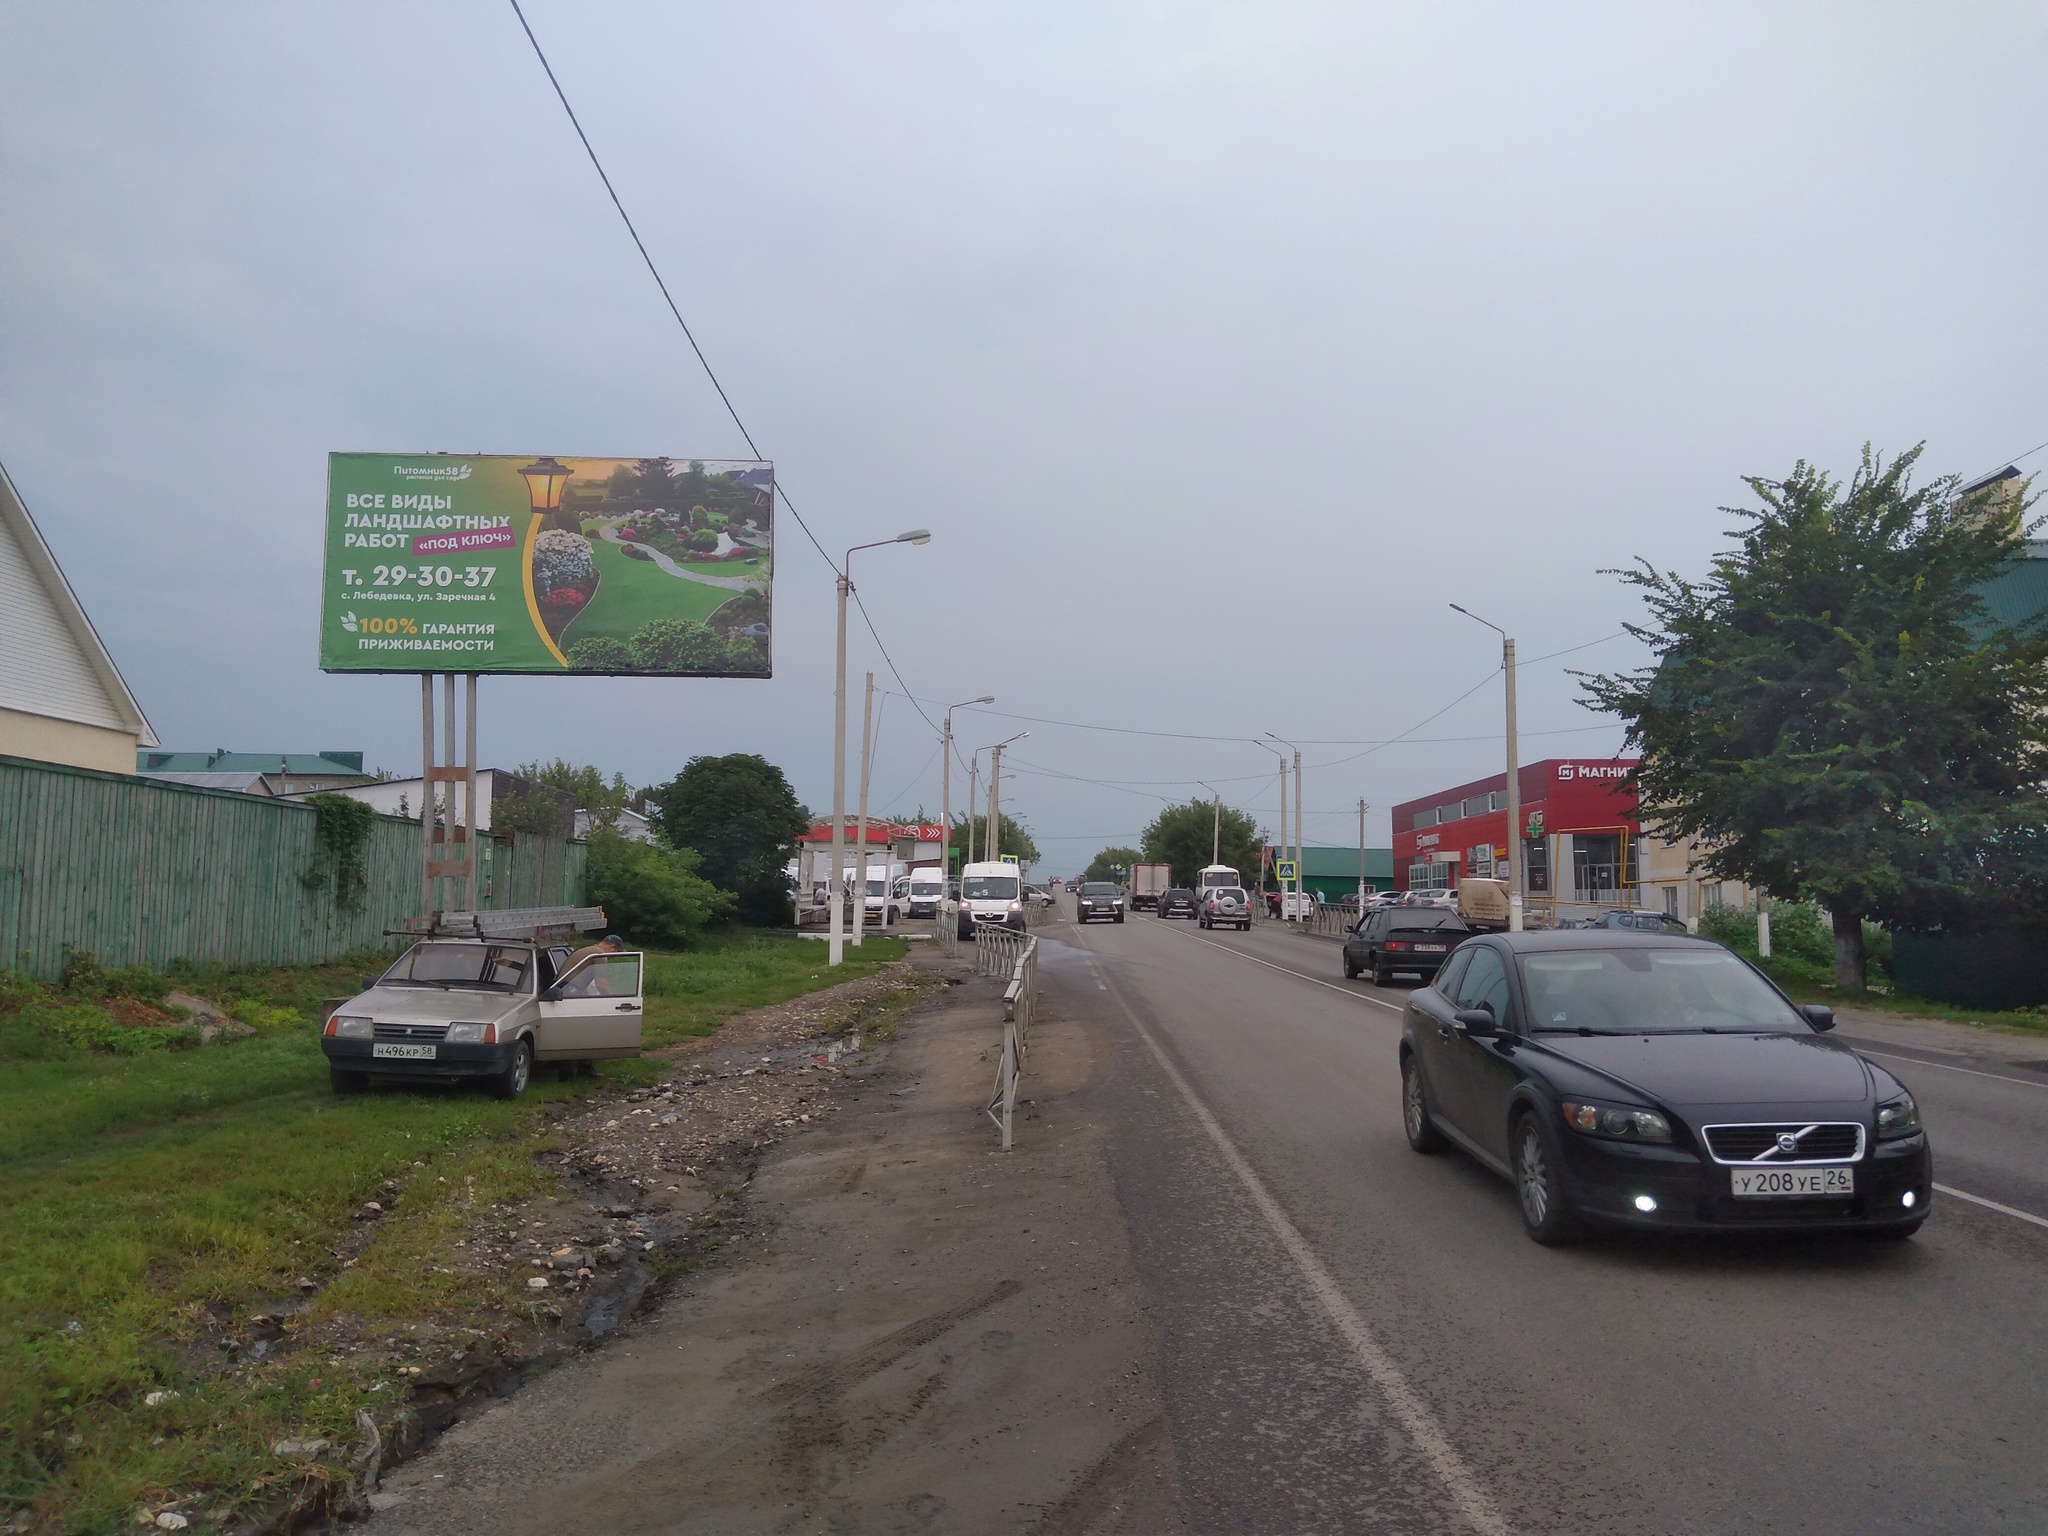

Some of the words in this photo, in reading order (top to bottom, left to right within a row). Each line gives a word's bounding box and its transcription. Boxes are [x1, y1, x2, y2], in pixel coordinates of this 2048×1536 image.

[393, 465, 458, 476] Питомник58
[346, 493, 385, 508] ВСЕ
[391, 494, 452, 511] ВИДЫ
[344, 513, 511, 530] ЛАНДШАФТНЫХ
[344, 533, 409, 548] РАБОТ
[418, 537, 459, 550] «ПОД
[461, 532, 512, 546] КЛЮЧ»
[342, 569, 363, 586] т.
[372, 565, 497, 587] 29-30-37
[353, 591, 414, 602] Лебедевка,
[417, 592, 433, 602] ул.
[436, 592, 486, 602] Заречная
[489, 593, 496, 601] 4
[359, 617, 418, 634] 100%
[422, 623, 495, 635] ГАРАНТИЯ
[358, 638, 494, 651] ПРИЖИВАЕМОСТИ
